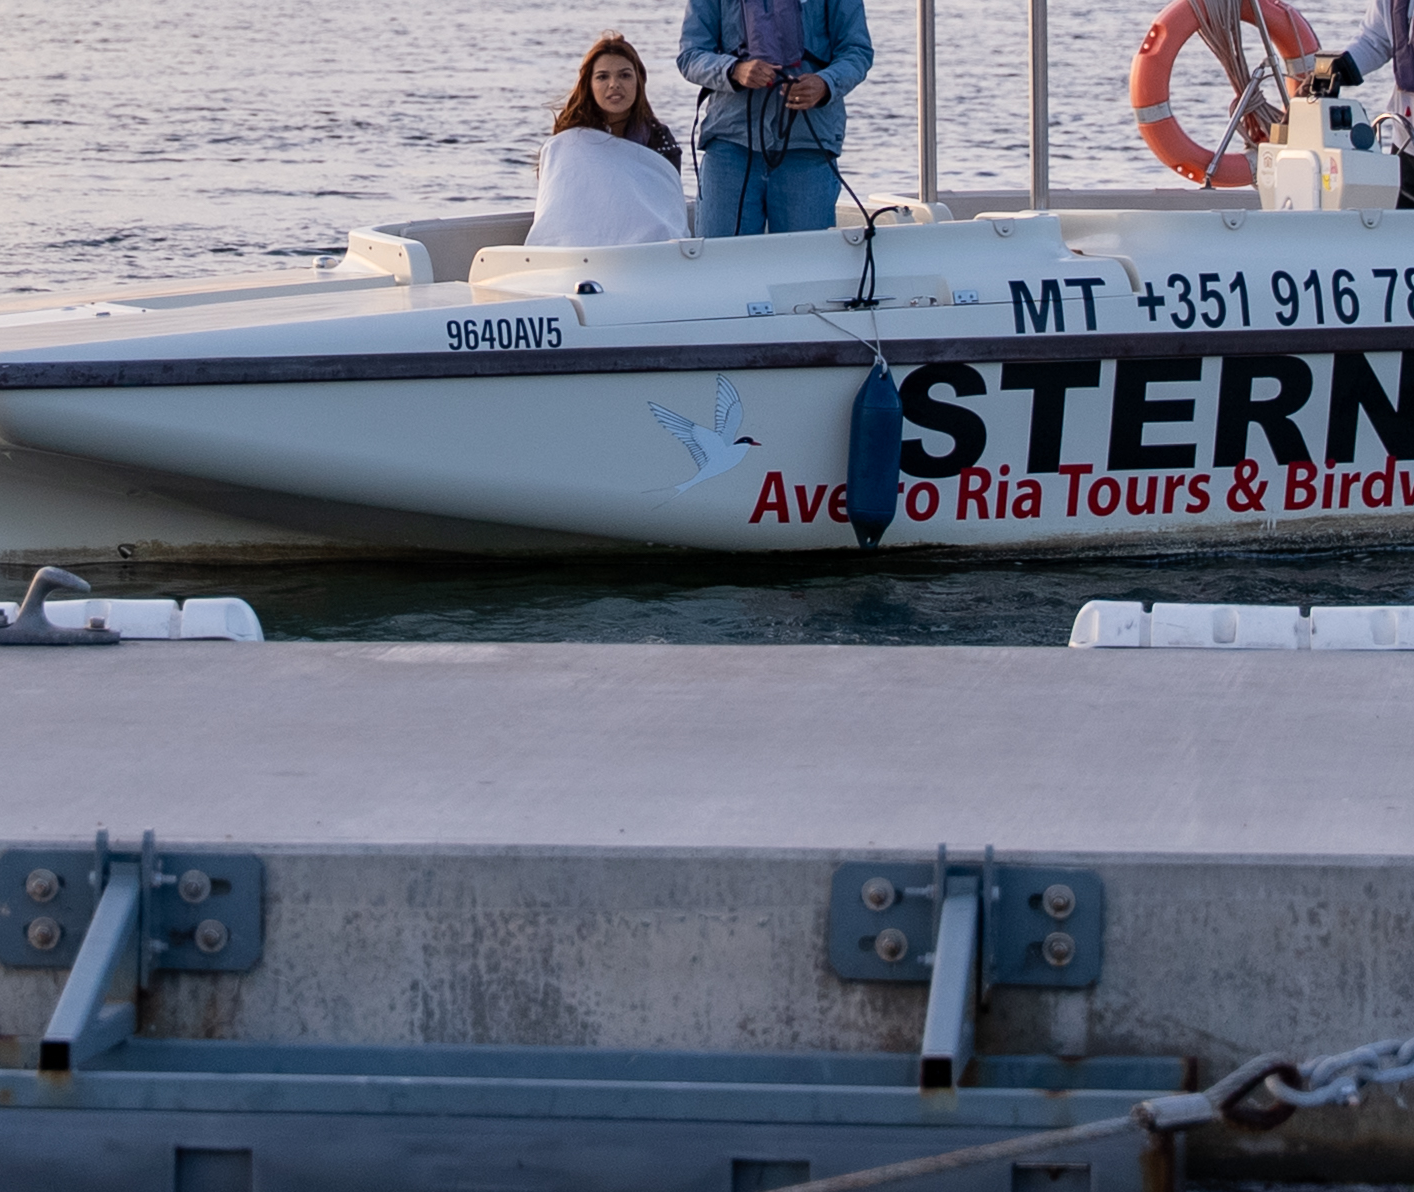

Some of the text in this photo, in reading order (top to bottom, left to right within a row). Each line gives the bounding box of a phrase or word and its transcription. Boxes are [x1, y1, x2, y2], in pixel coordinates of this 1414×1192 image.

[446, 316, 563, 351] 9640AV5
[1008, 277, 1106, 334] MT
[1137, 271, 1251, 330] +351
[1271, 268, 1360, 327] 916
[748, 471, 941, 524] Aveo
[955, 463, 1043, 521] Ria
[1058, 463, 1212, 517] Tours
[1226, 458, 1269, 513] &
